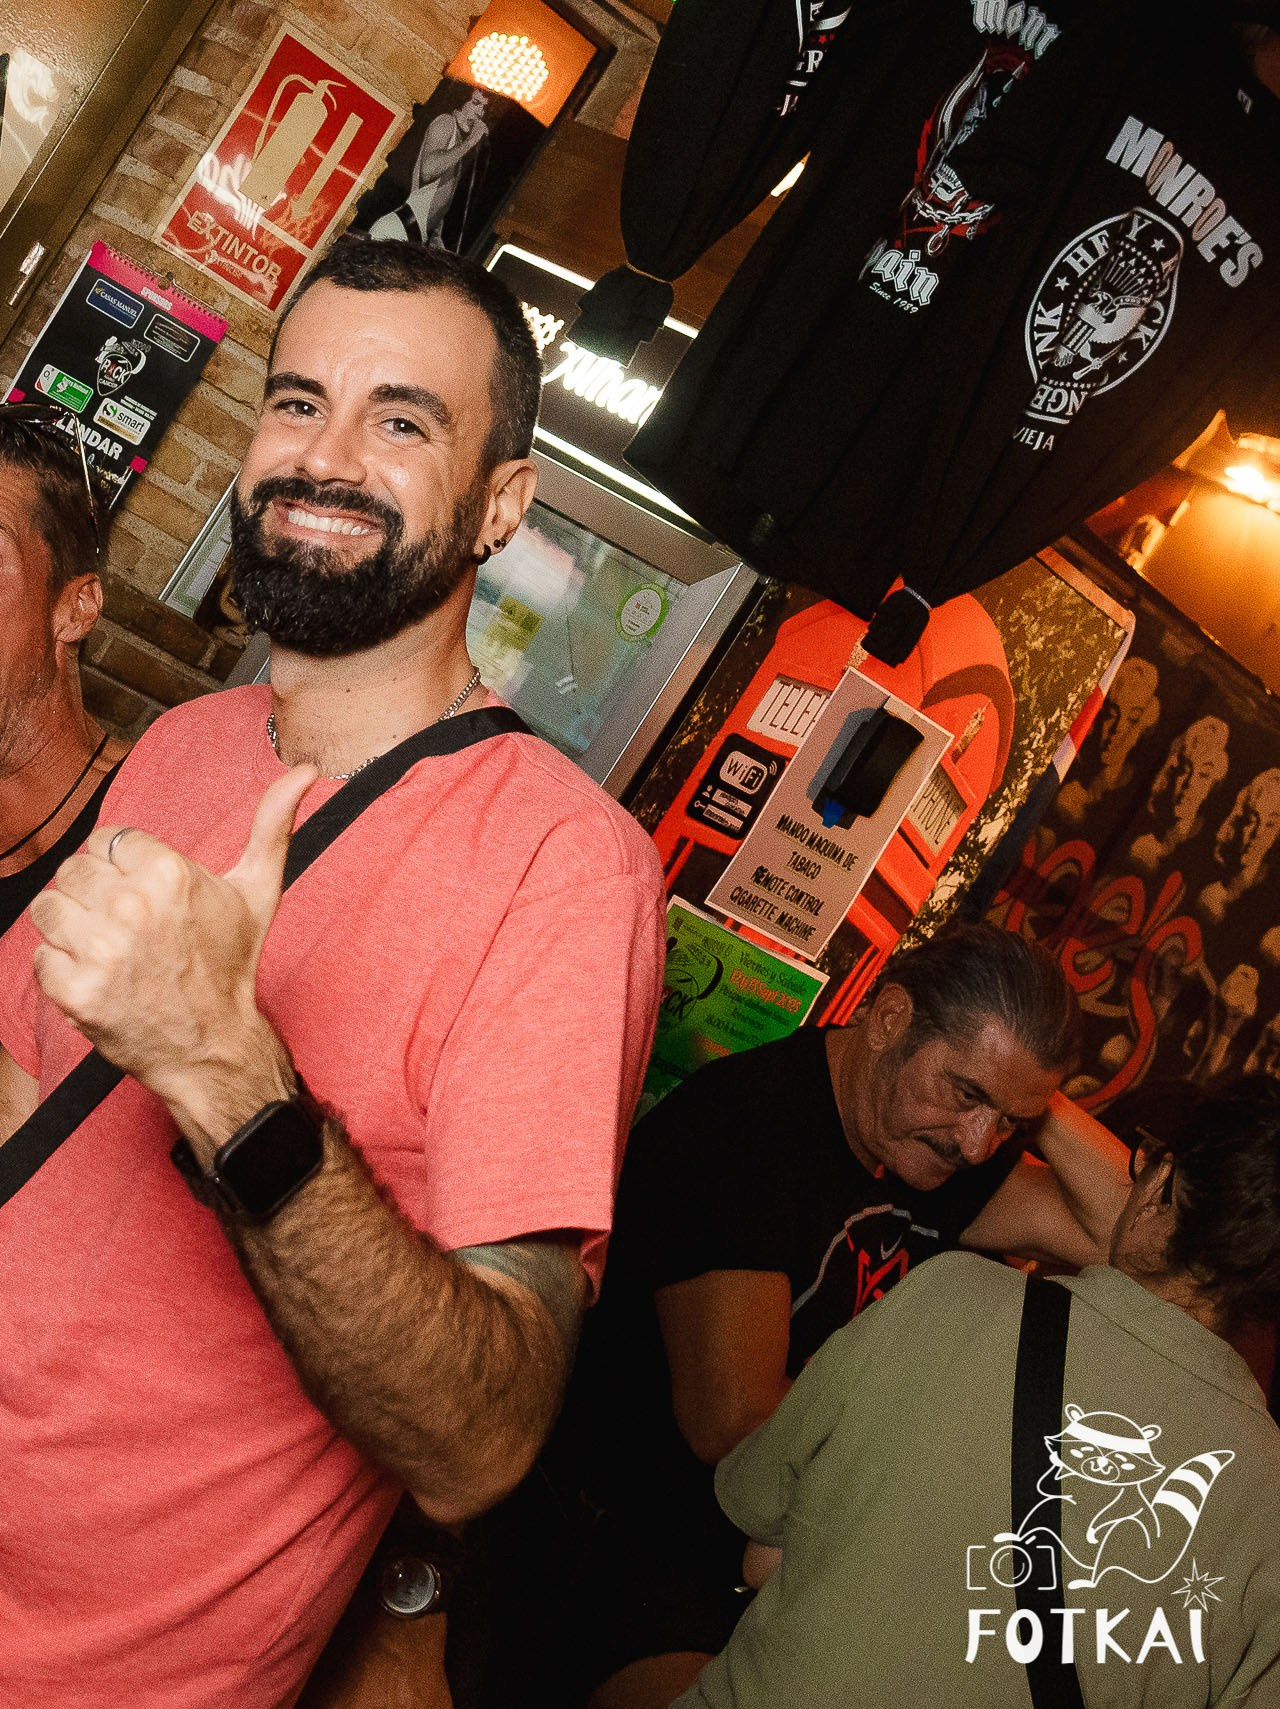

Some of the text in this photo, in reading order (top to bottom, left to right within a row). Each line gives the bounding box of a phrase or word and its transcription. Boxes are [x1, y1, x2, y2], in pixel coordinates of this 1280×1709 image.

[1105, 115, 1264, 288] MONROE'S
[186, 209, 282, 282] EXTINTOR
[100, 292, 118, 305] CASAS
[868, 281, 919, 315] Since 1989
[117, 411, 146, 434] smart
[777, 814, 859, 871] MANDO MAQUINA DE
[786, 850, 822, 879] TABACO
[730, 886, 816, 941] CIGARETTE MACHINE
[752, 865, 824, 917] REMOTE CONTROL
